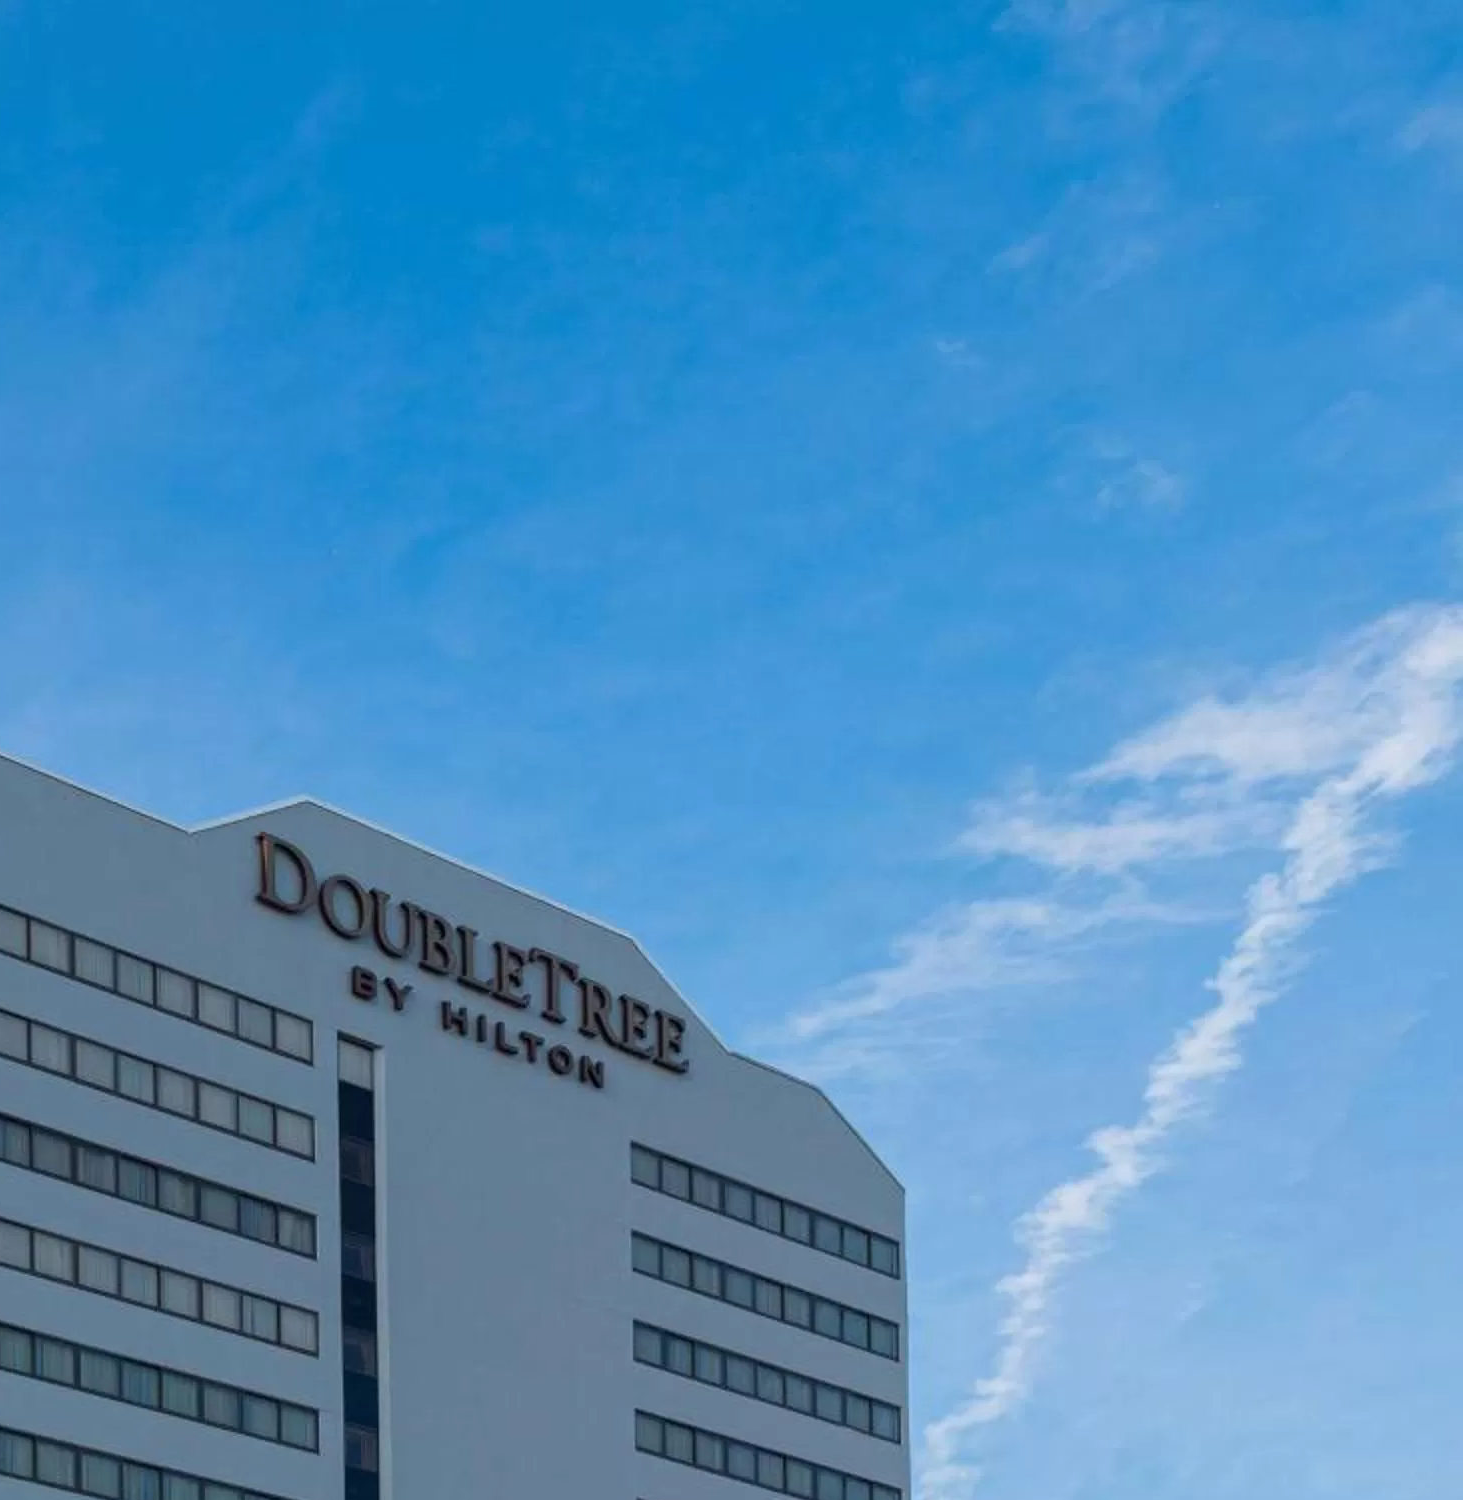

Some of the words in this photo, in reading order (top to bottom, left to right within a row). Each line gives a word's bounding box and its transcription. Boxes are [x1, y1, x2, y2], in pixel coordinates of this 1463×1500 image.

[254, 831, 689, 1075] DOUBLETREE
[351, 964, 414, 1012] BY
[440, 1001, 606, 1089] HILTON
